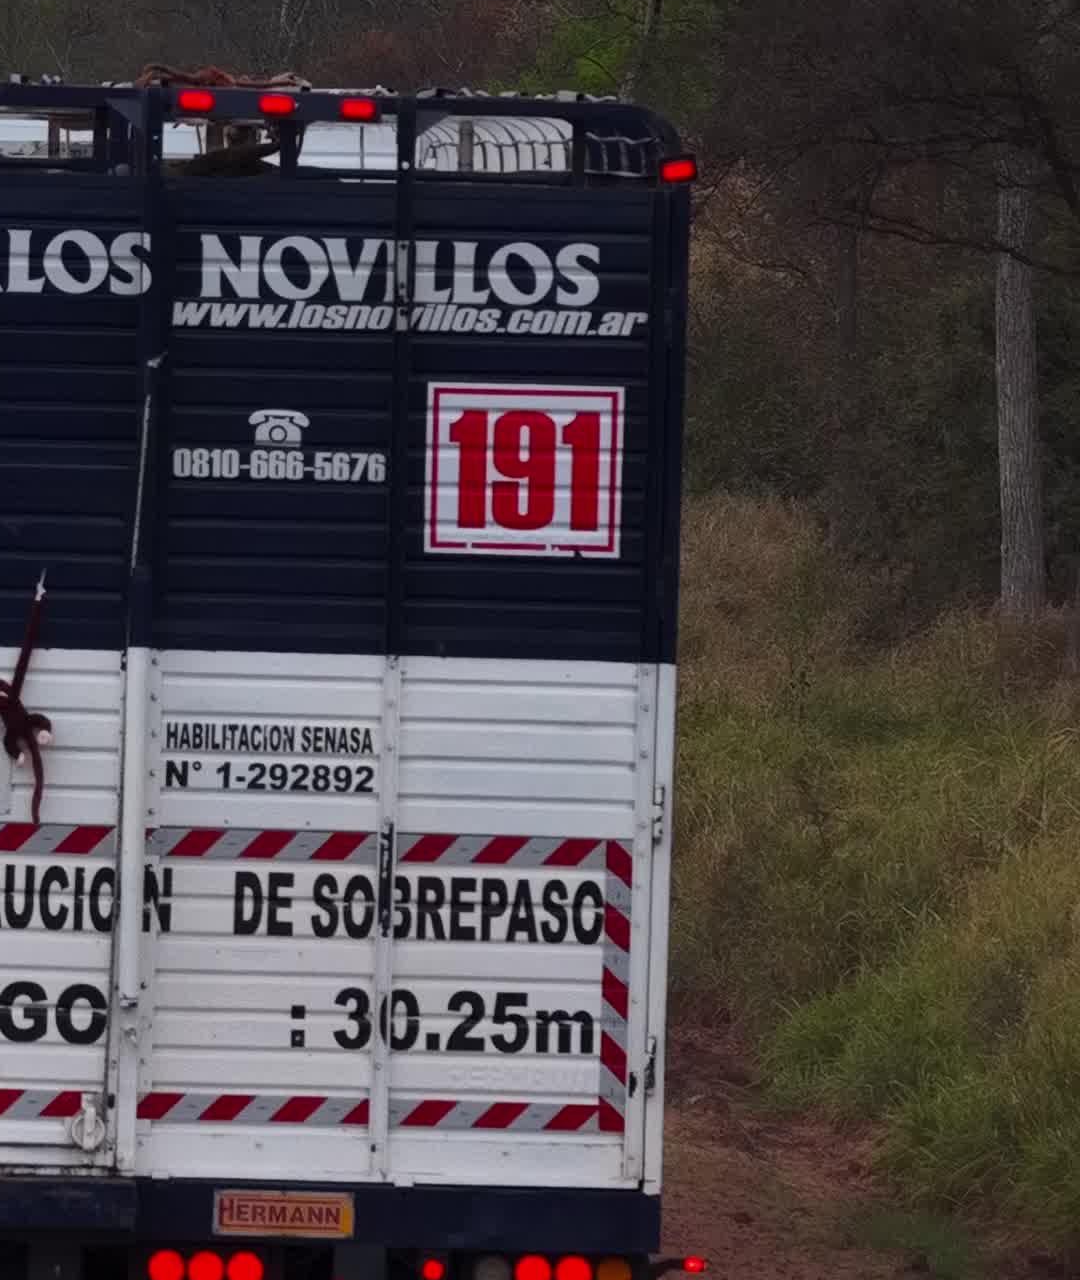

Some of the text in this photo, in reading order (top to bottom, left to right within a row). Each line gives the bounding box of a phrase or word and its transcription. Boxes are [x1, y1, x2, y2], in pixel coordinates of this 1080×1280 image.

[6, 229, 600, 307] LOS NOVILLOS
[172, 301, 648, 336] www.losnovillos.com.ar
[173, 448, 386, 482] 0810-666-5676
[449, 409, 600, 531] 191
[166, 722, 373, 754] HABILITACION SENASA
[217, 761, 374, 792] 1-292892
[234, 871, 295, 937] DE
[311, 873, 603, 945] SOBREPASO
[219, 1197, 341, 1228] HERMANN
